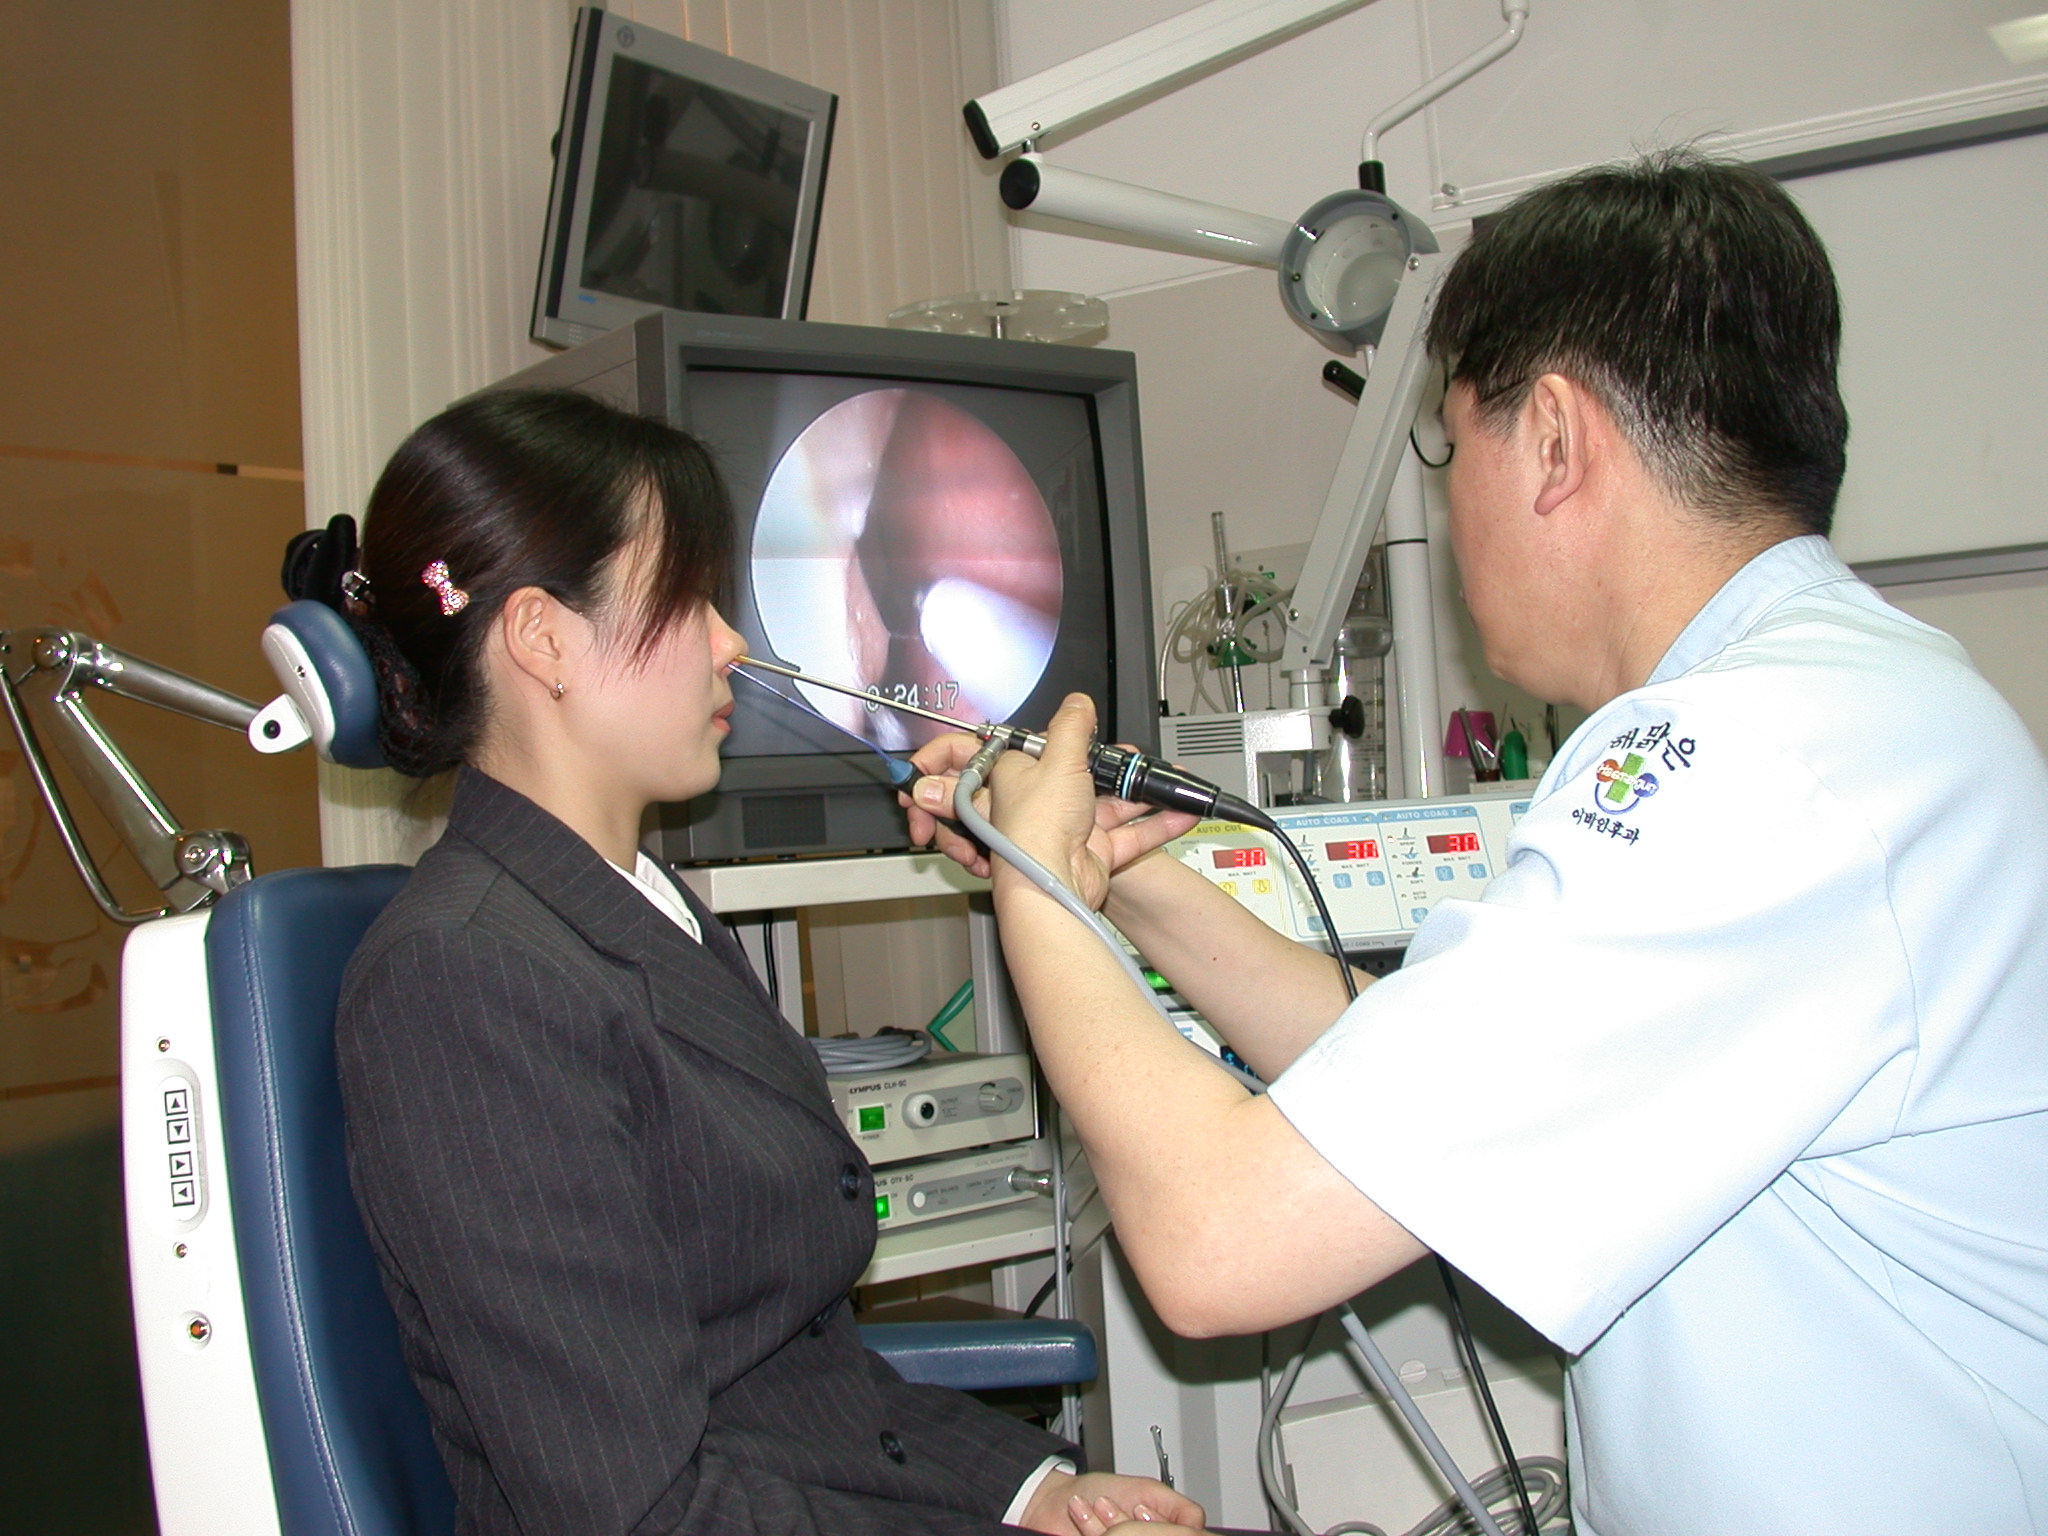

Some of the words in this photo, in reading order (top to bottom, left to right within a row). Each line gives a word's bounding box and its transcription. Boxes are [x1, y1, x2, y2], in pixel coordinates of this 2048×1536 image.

[1296, 818, 1320, 826] AUTO
[1323, 816, 1349, 824] COAG
[1396, 811, 1420, 819] AUTO
[1347, 841, 1377, 861] 30
[1448, 834, 1478, 854] 30
[1234, 848, 1264, 869] 30
